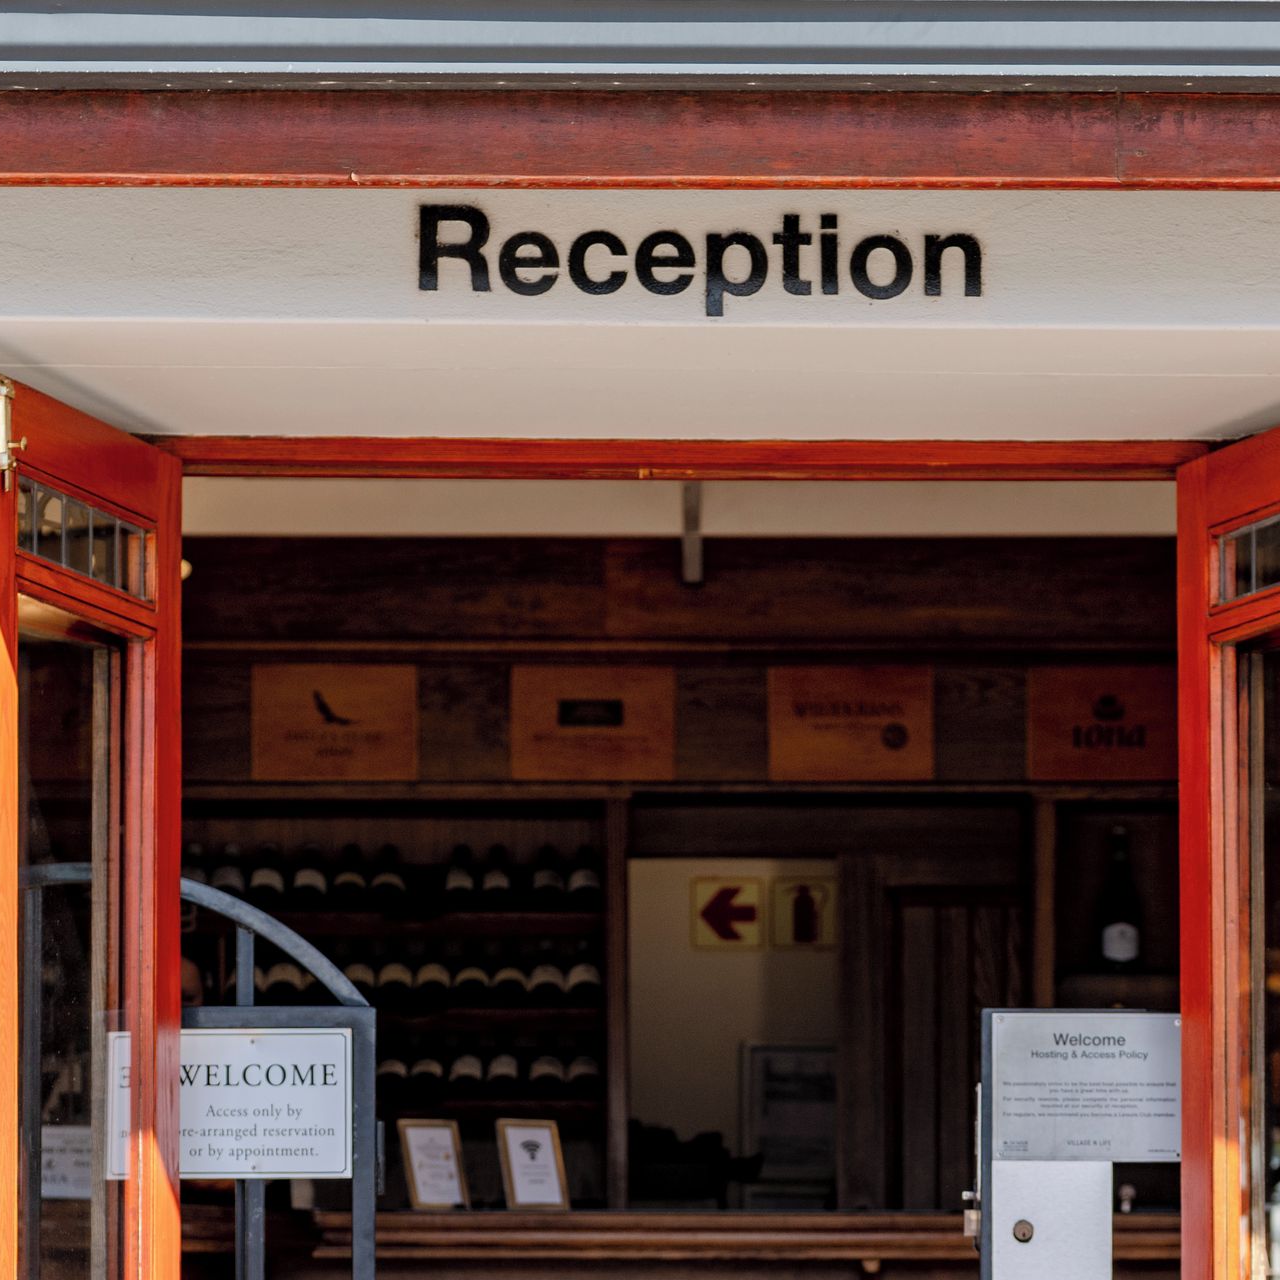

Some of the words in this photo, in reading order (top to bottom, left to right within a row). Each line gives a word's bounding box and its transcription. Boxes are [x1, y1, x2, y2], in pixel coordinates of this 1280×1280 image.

[418, 203, 983, 318] Reception
[1053, 1033, 1126, 1047] Welcome
[1031, 1050, 1068, 1061] Hosting
[1071, 1050, 1078, 1059] &
[1081, 1050, 1116, 1059] Access
[1119, 1050, 1149, 1061] Policy
[179, 1064, 338, 1087] WELCOME
[206, 1105, 248, 1118] Access
[252, 1105, 281, 1120] only
[287, 1105, 303, 1120] by
[178, 1125, 258, 1139] re-arranged
[263, 1125, 336, 1137] reservation
[189, 1148, 202, 1157] or
[208, 1145, 223, 1160] by
[228, 1145, 319, 1160] appointment.
